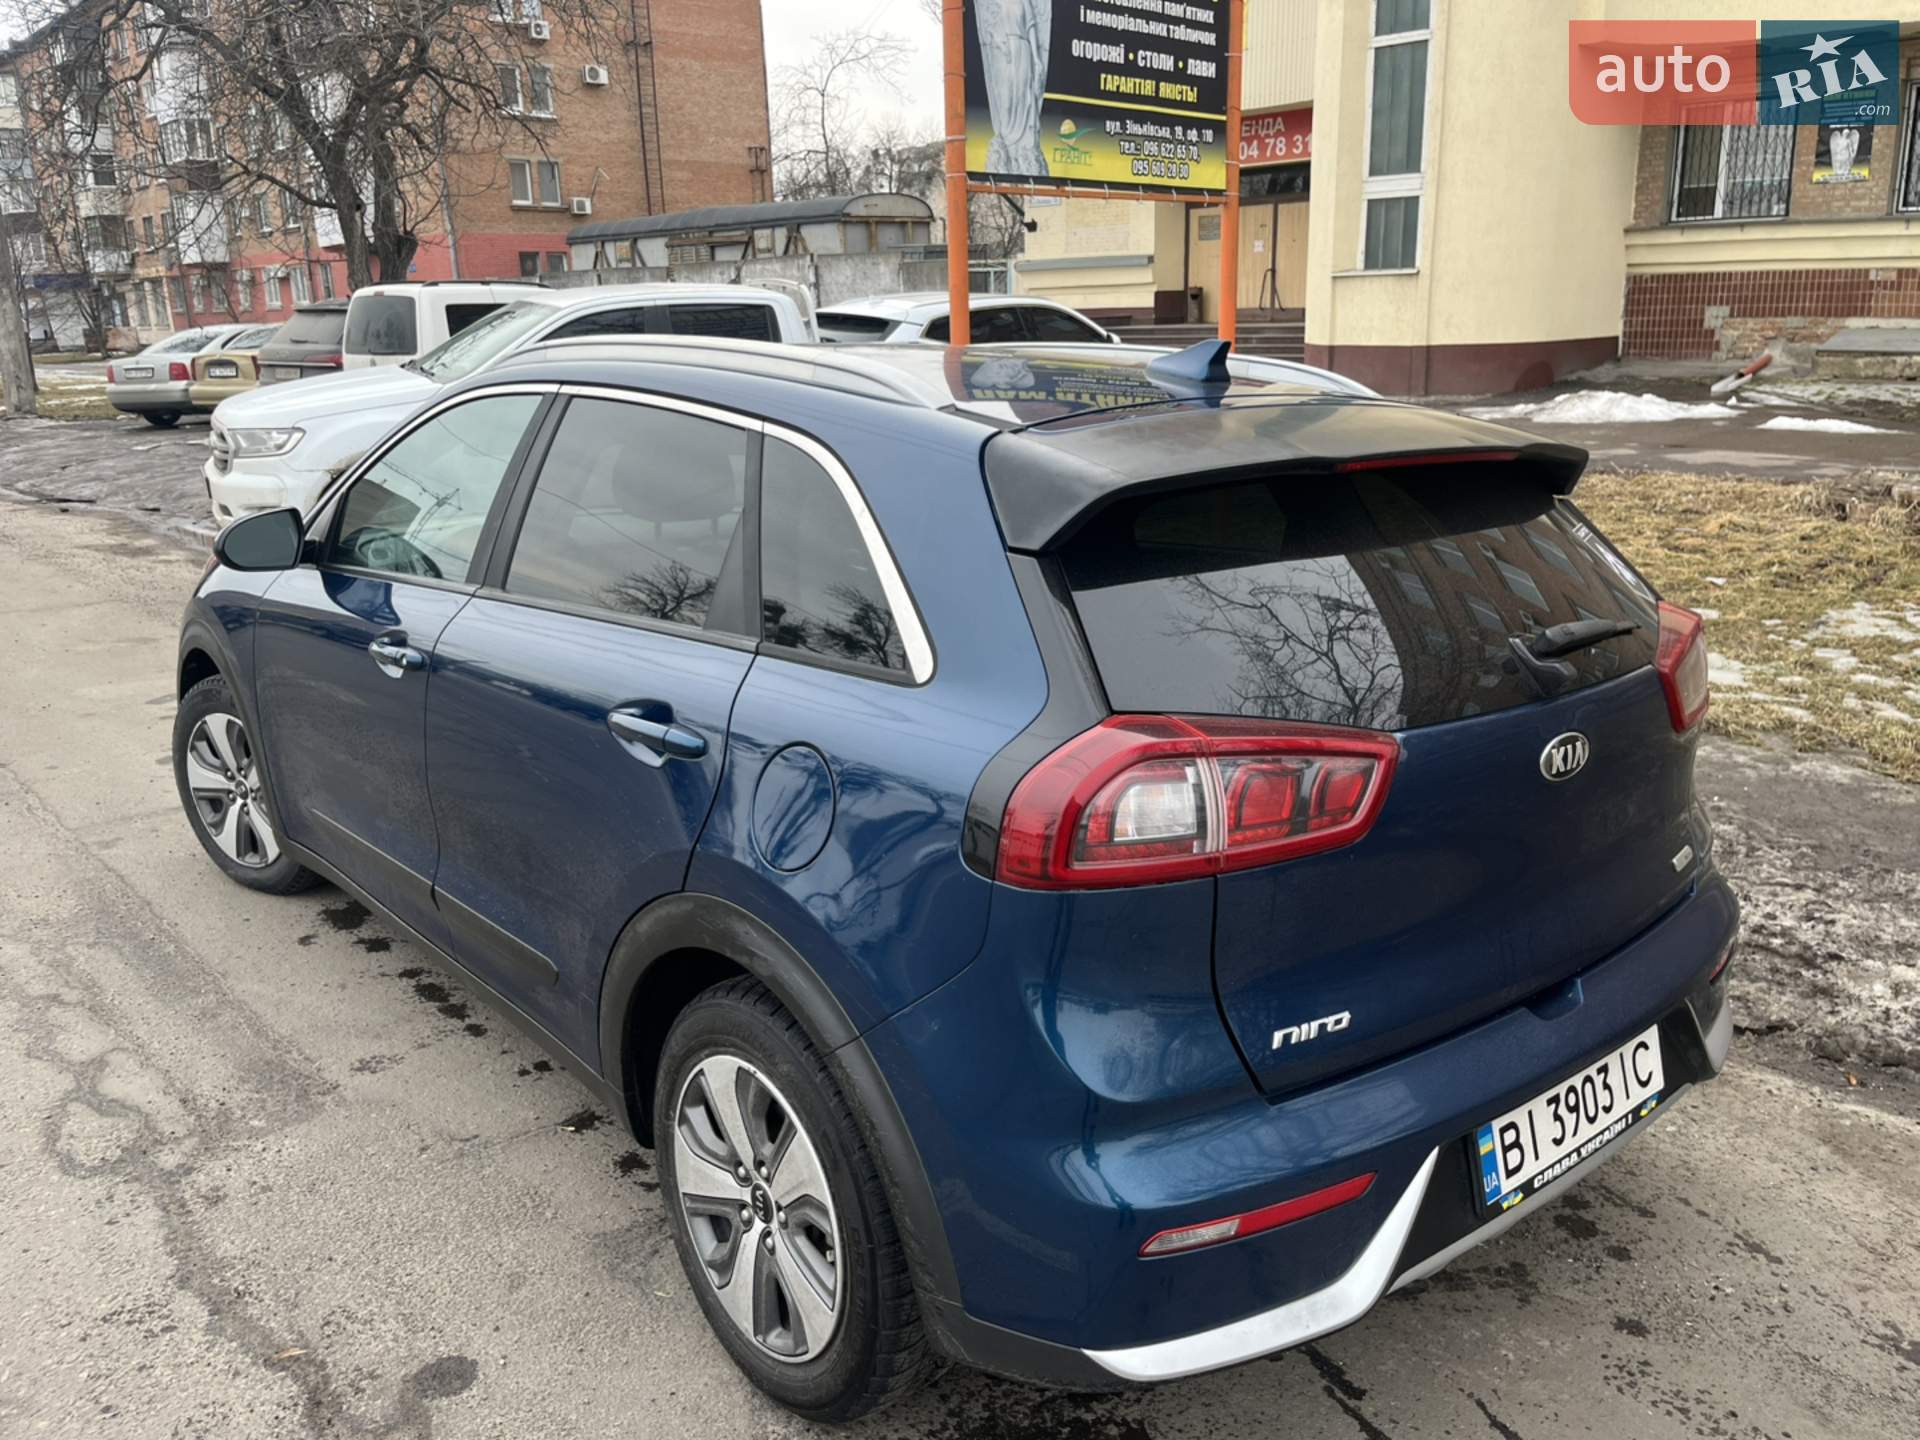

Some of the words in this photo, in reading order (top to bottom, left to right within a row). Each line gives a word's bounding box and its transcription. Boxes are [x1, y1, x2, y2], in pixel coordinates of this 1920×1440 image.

[1079, 5, 1085, 22] і
[1086, 9, 1168, 37] меморіальних
[1169, 24, 1216, 46] табличок
[1071, 39, 1125, 64] огорожі
[1137, 49, 1174, 72] столи
[1186, 58, 1217, 79] лави
[1100, 73, 1156, 96] ГАРАНТІЯ!
[1159, 82, 1198, 102] ЯКІСТЬ!
[1105, 120, 1123, 135] вул.
[1242, 116, 1285, 137] ЕНДА
[1143, 140, 1159, 156] 096
[1160, 142, 1175, 158] 622
[1264, 137, 1286, 158] 78
[1132, 159, 1149, 175] 095
[1551, 740, 1584, 775] KIA
[1272, 1010, 1352, 1050] niro
[1499, 1109, 1539, 1180] BI
[1546, 1062, 1614, 1147] 3903
[1619, 1040, 1653, 1101] IC
[1483, 1171, 1499, 1192] UA
[1533, 1151, 1579, 1188] СЛАВА
